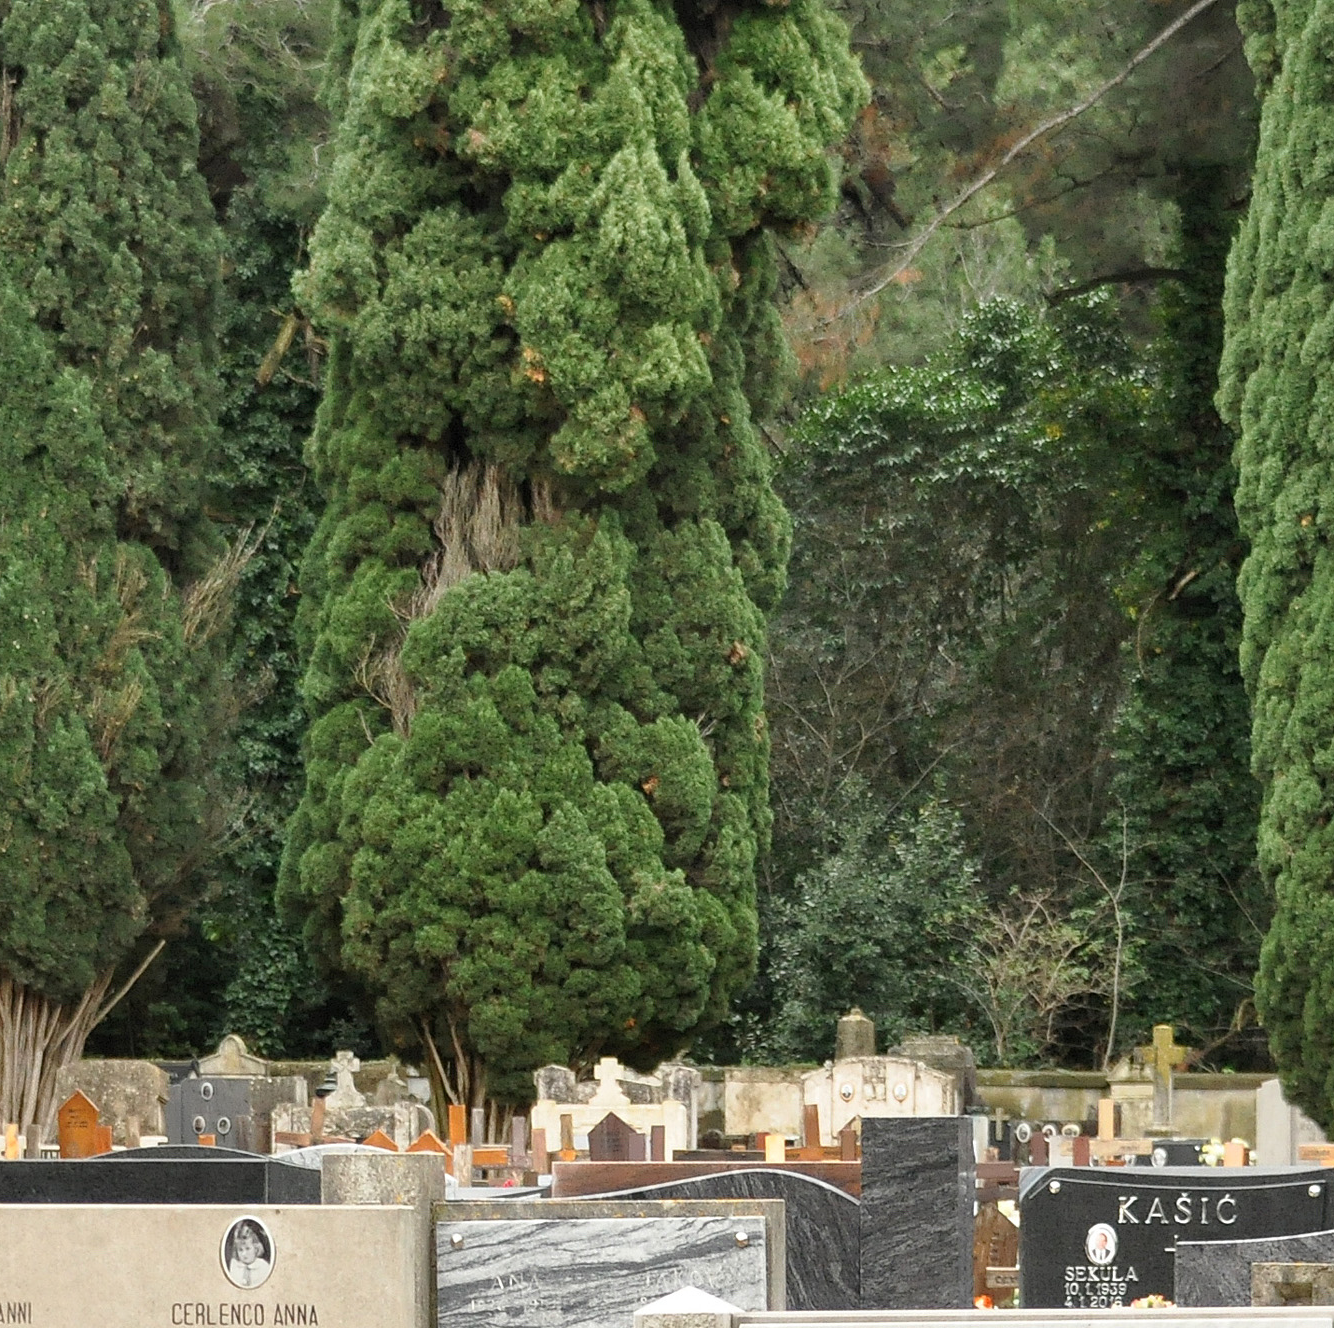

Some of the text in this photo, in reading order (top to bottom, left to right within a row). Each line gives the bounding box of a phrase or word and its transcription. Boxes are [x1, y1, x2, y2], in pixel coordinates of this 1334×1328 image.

[1117, 1193, 1238, 1225] KAŠIĆ
[1064, 1266, 1139, 1282] SEKULA
[171, 1303, 319, 1326] CERLENCO ANNA
